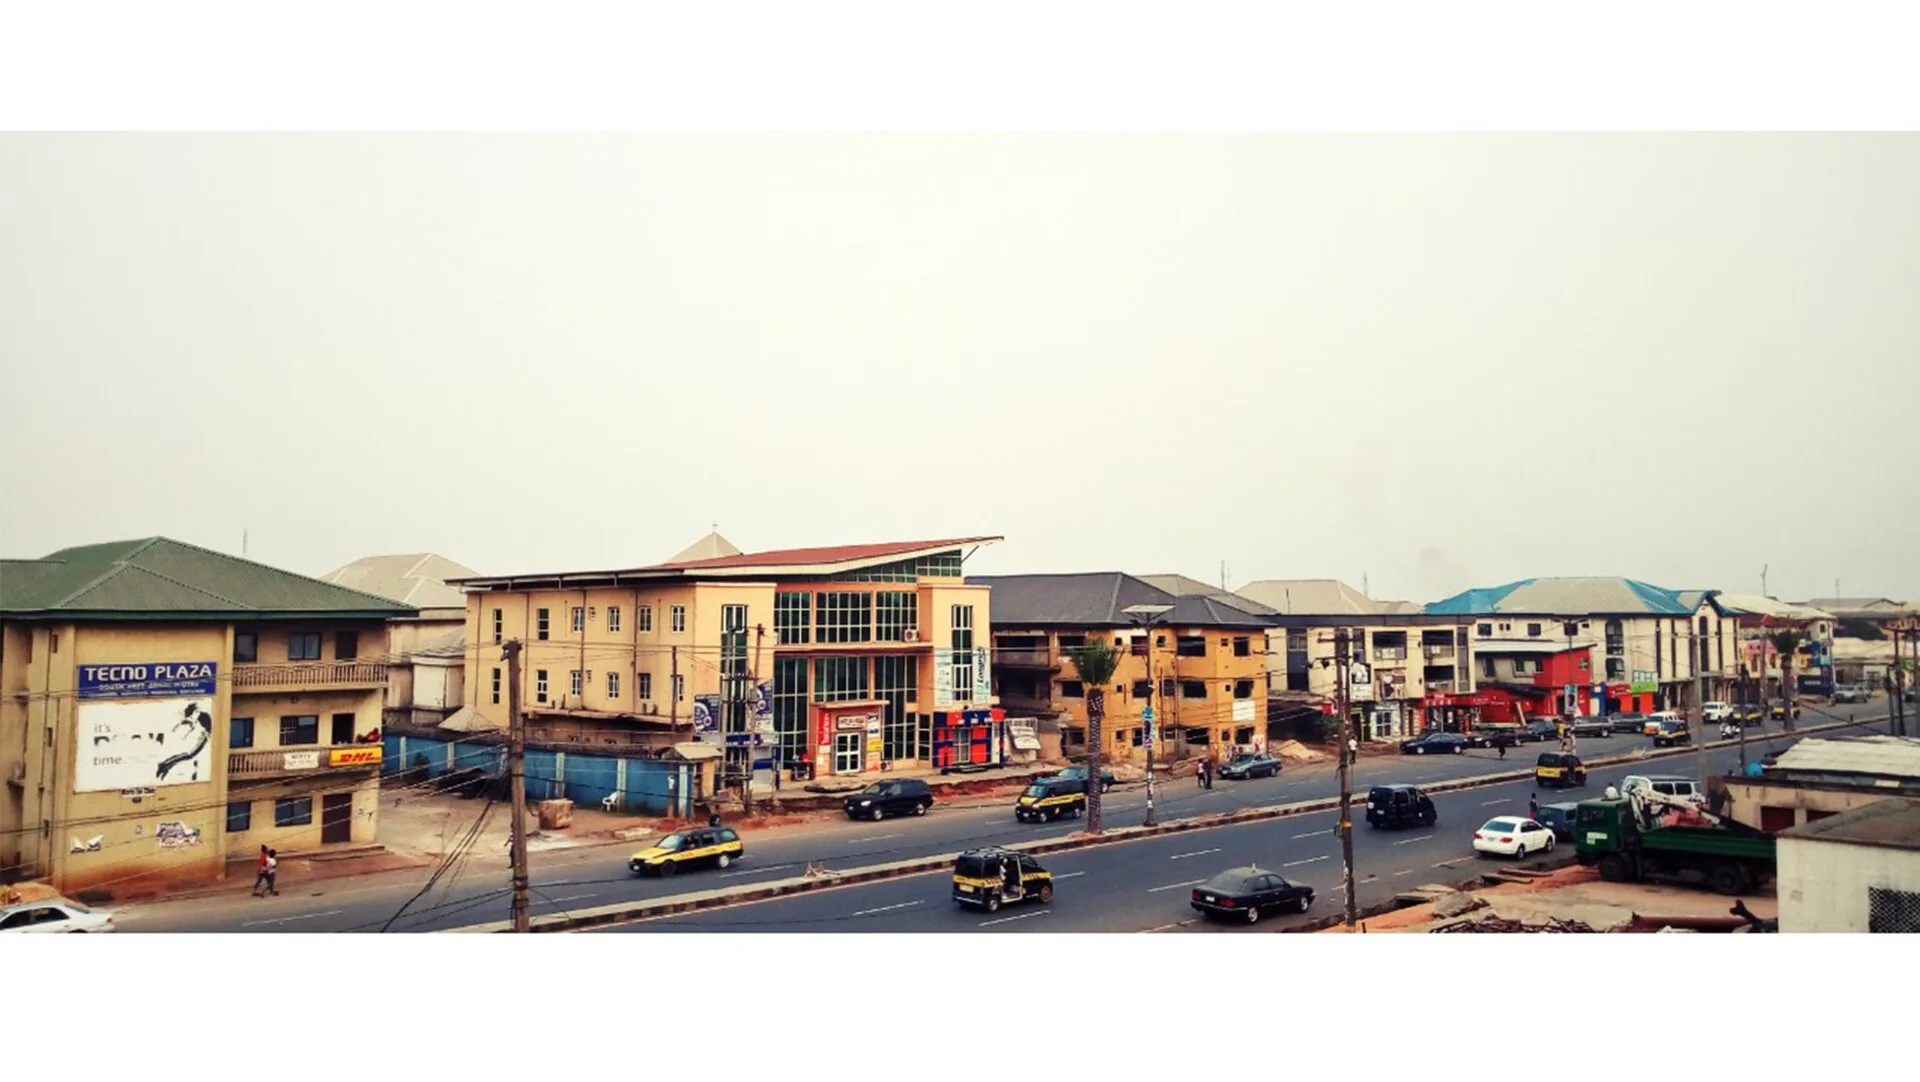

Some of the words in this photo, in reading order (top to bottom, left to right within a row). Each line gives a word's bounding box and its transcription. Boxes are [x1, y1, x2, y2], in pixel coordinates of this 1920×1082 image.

[85, 666, 147, 681] TECNO
[155, 664, 212, 679] PLAZA
[93, 756, 123, 766] time
[340, 752, 375, 762] DHL
